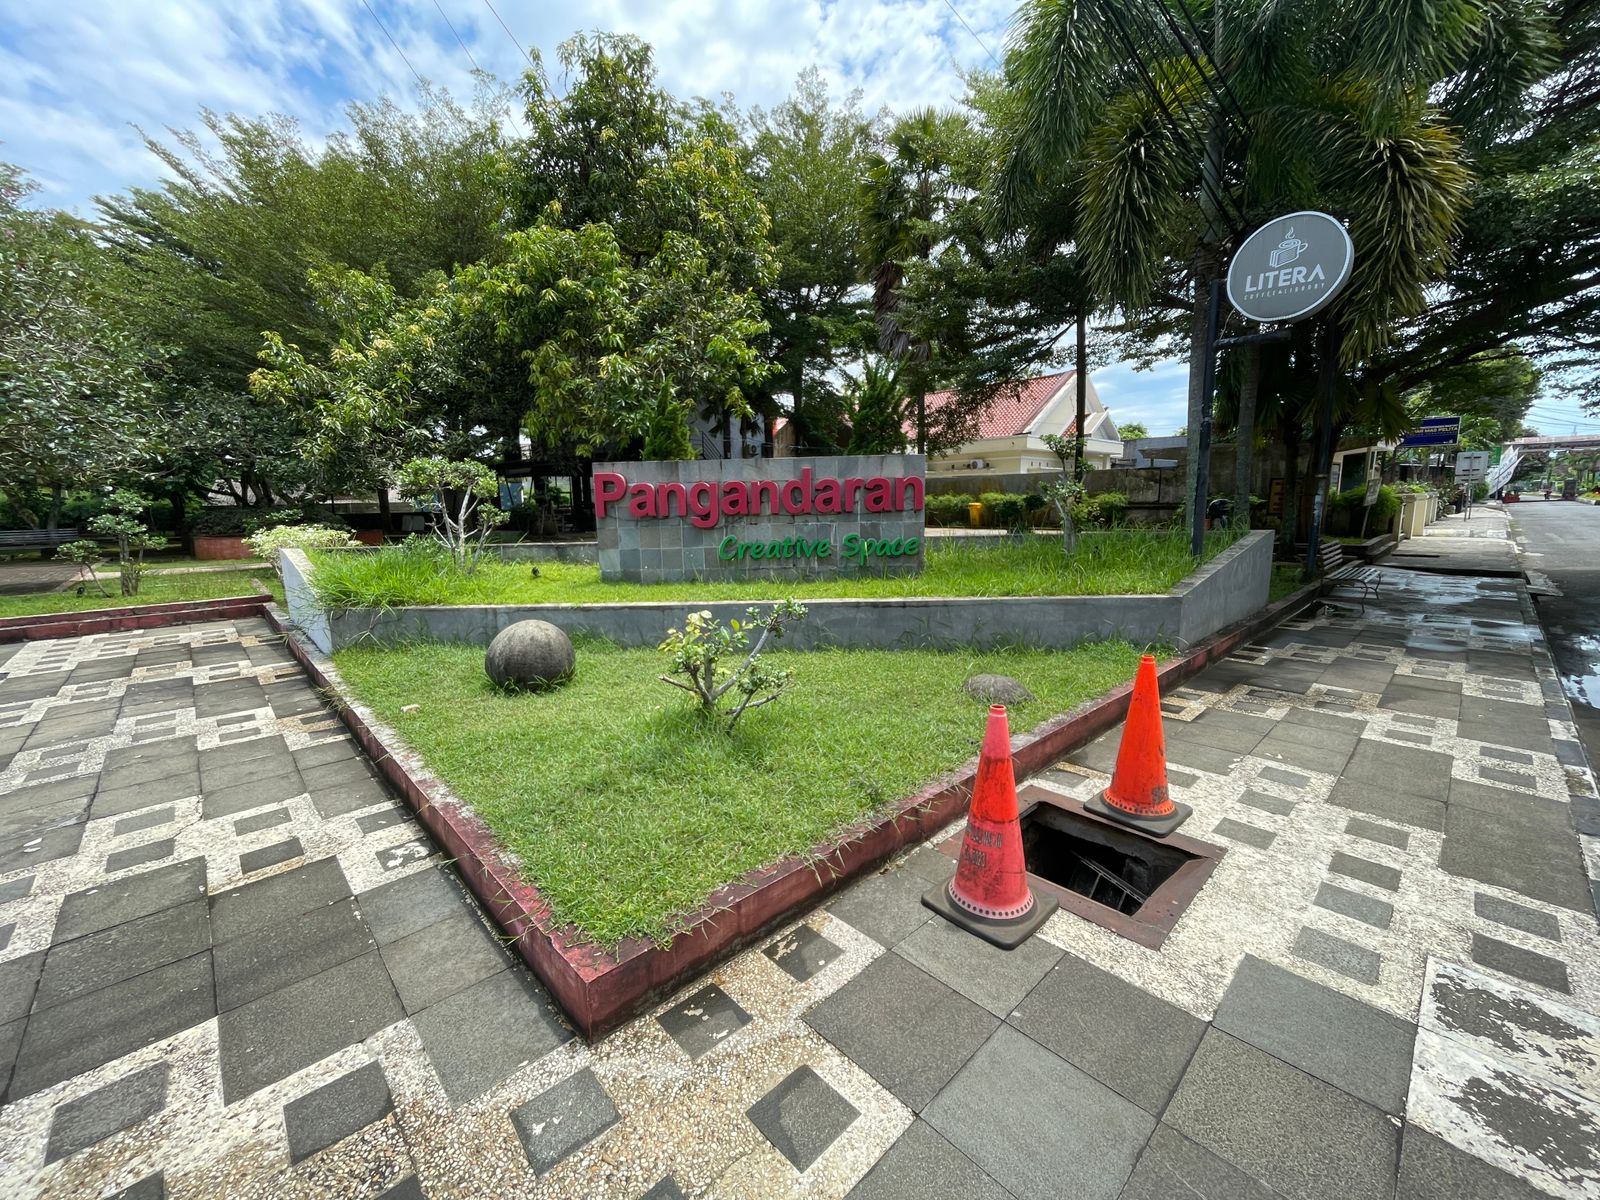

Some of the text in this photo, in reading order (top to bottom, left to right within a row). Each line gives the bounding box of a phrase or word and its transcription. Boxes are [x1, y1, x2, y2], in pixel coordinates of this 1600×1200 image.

[1245, 264, 1325, 292] LITERA
[593, 467, 924, 528] Pangandaran
[719, 533, 919, 565] Creative Space
